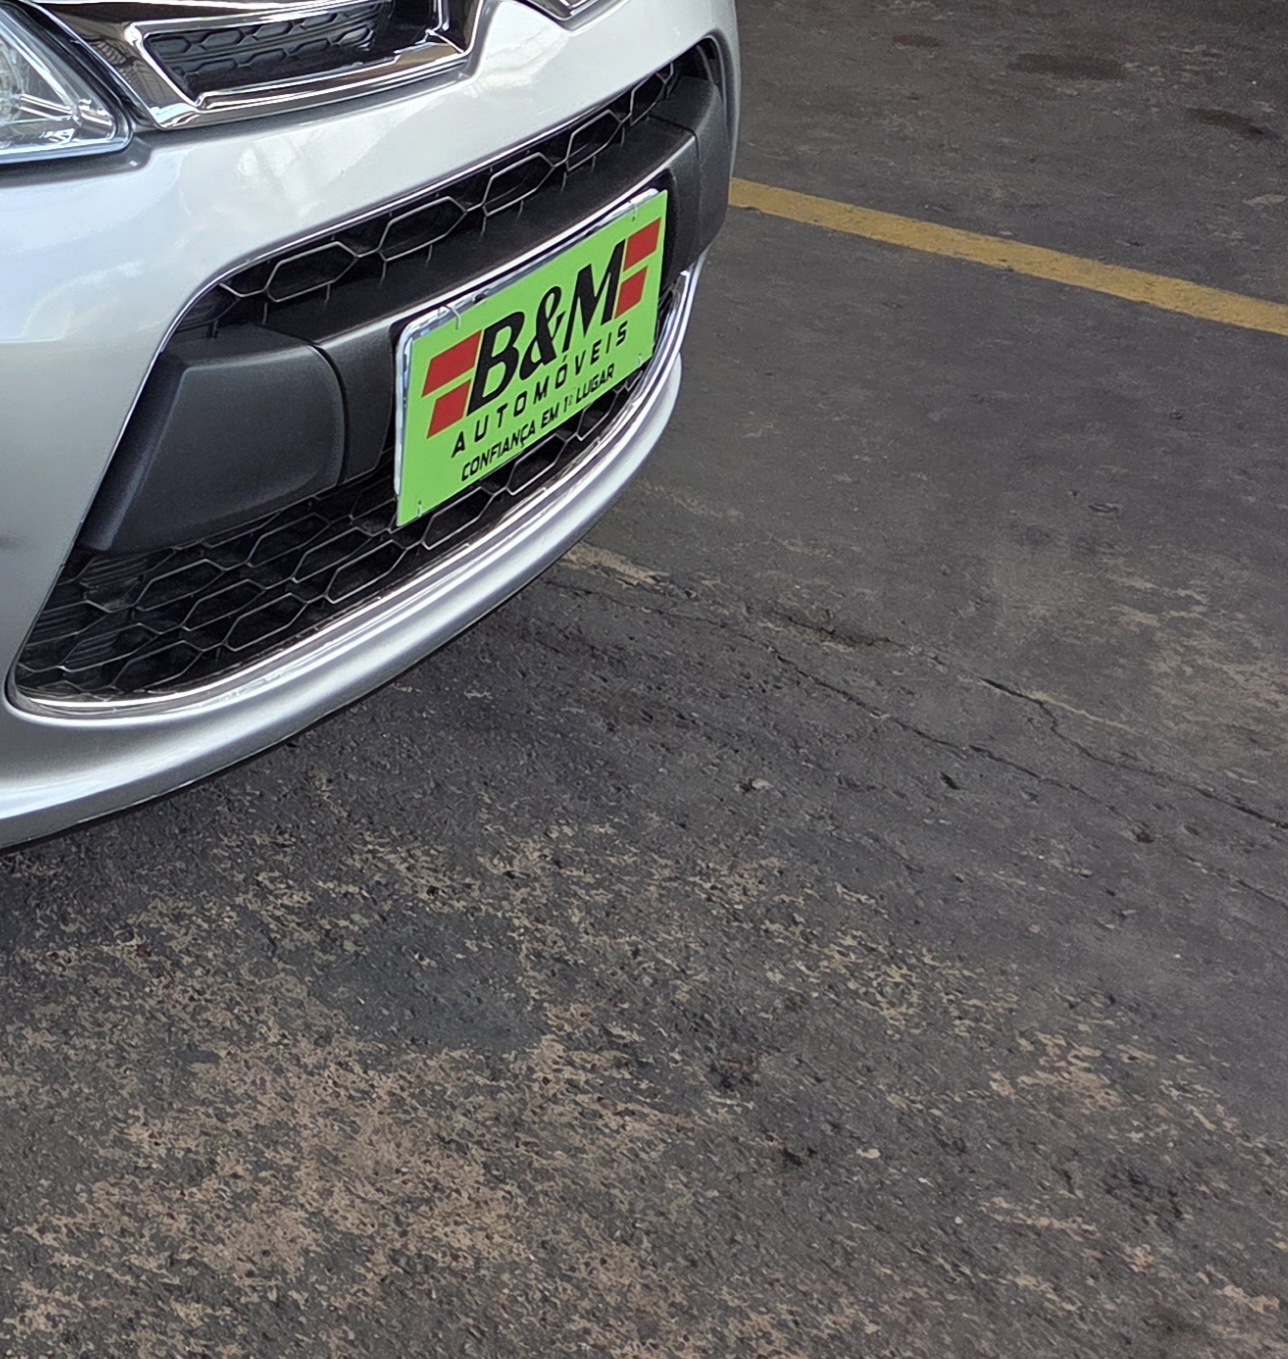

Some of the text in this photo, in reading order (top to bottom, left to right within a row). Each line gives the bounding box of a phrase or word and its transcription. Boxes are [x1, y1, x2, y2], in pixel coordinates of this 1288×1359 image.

[451, 321, 628, 458] AUTOMÓVEIS
[466, 238, 626, 416] B&M
[461, 419, 535, 481] CONFIANÇA
[540, 402, 560, 429] EM
[576, 363, 614, 403] LUGAR
